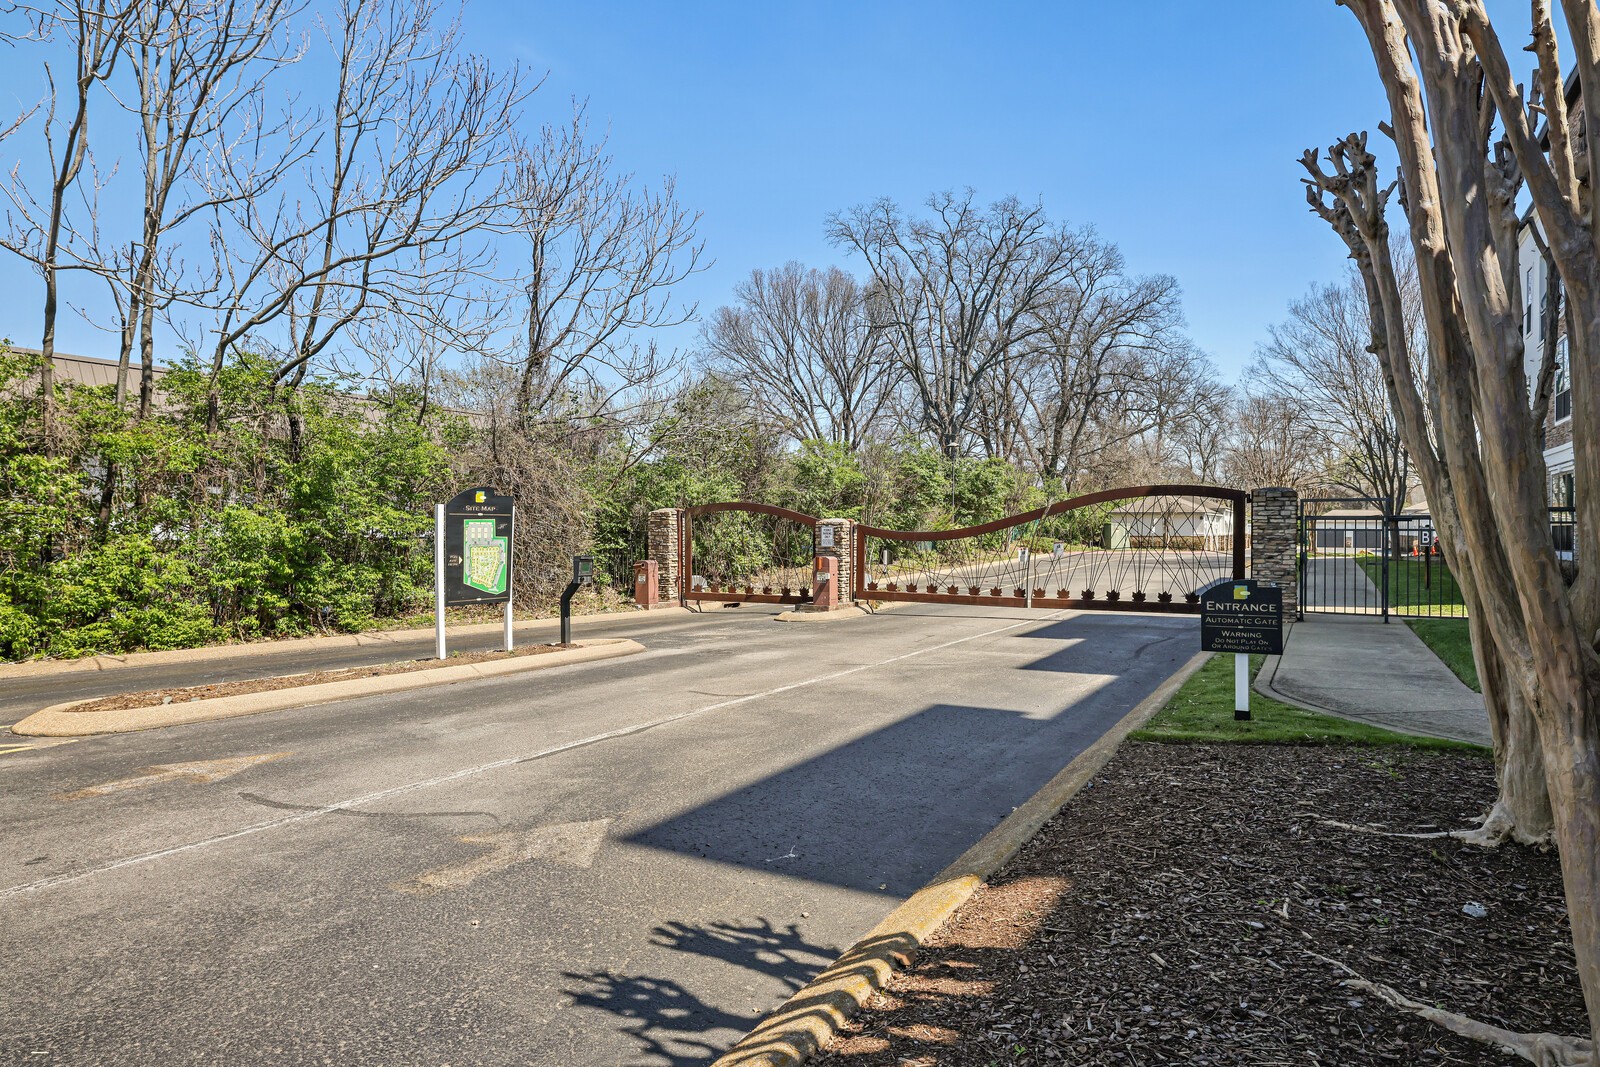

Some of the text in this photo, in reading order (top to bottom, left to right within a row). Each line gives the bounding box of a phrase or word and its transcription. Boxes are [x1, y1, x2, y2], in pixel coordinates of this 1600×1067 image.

[1422, 531, 1430, 544] B
[1206, 601, 1278, 612] ENTRANCE
[1221, 630, 1262, 638] WARNING
